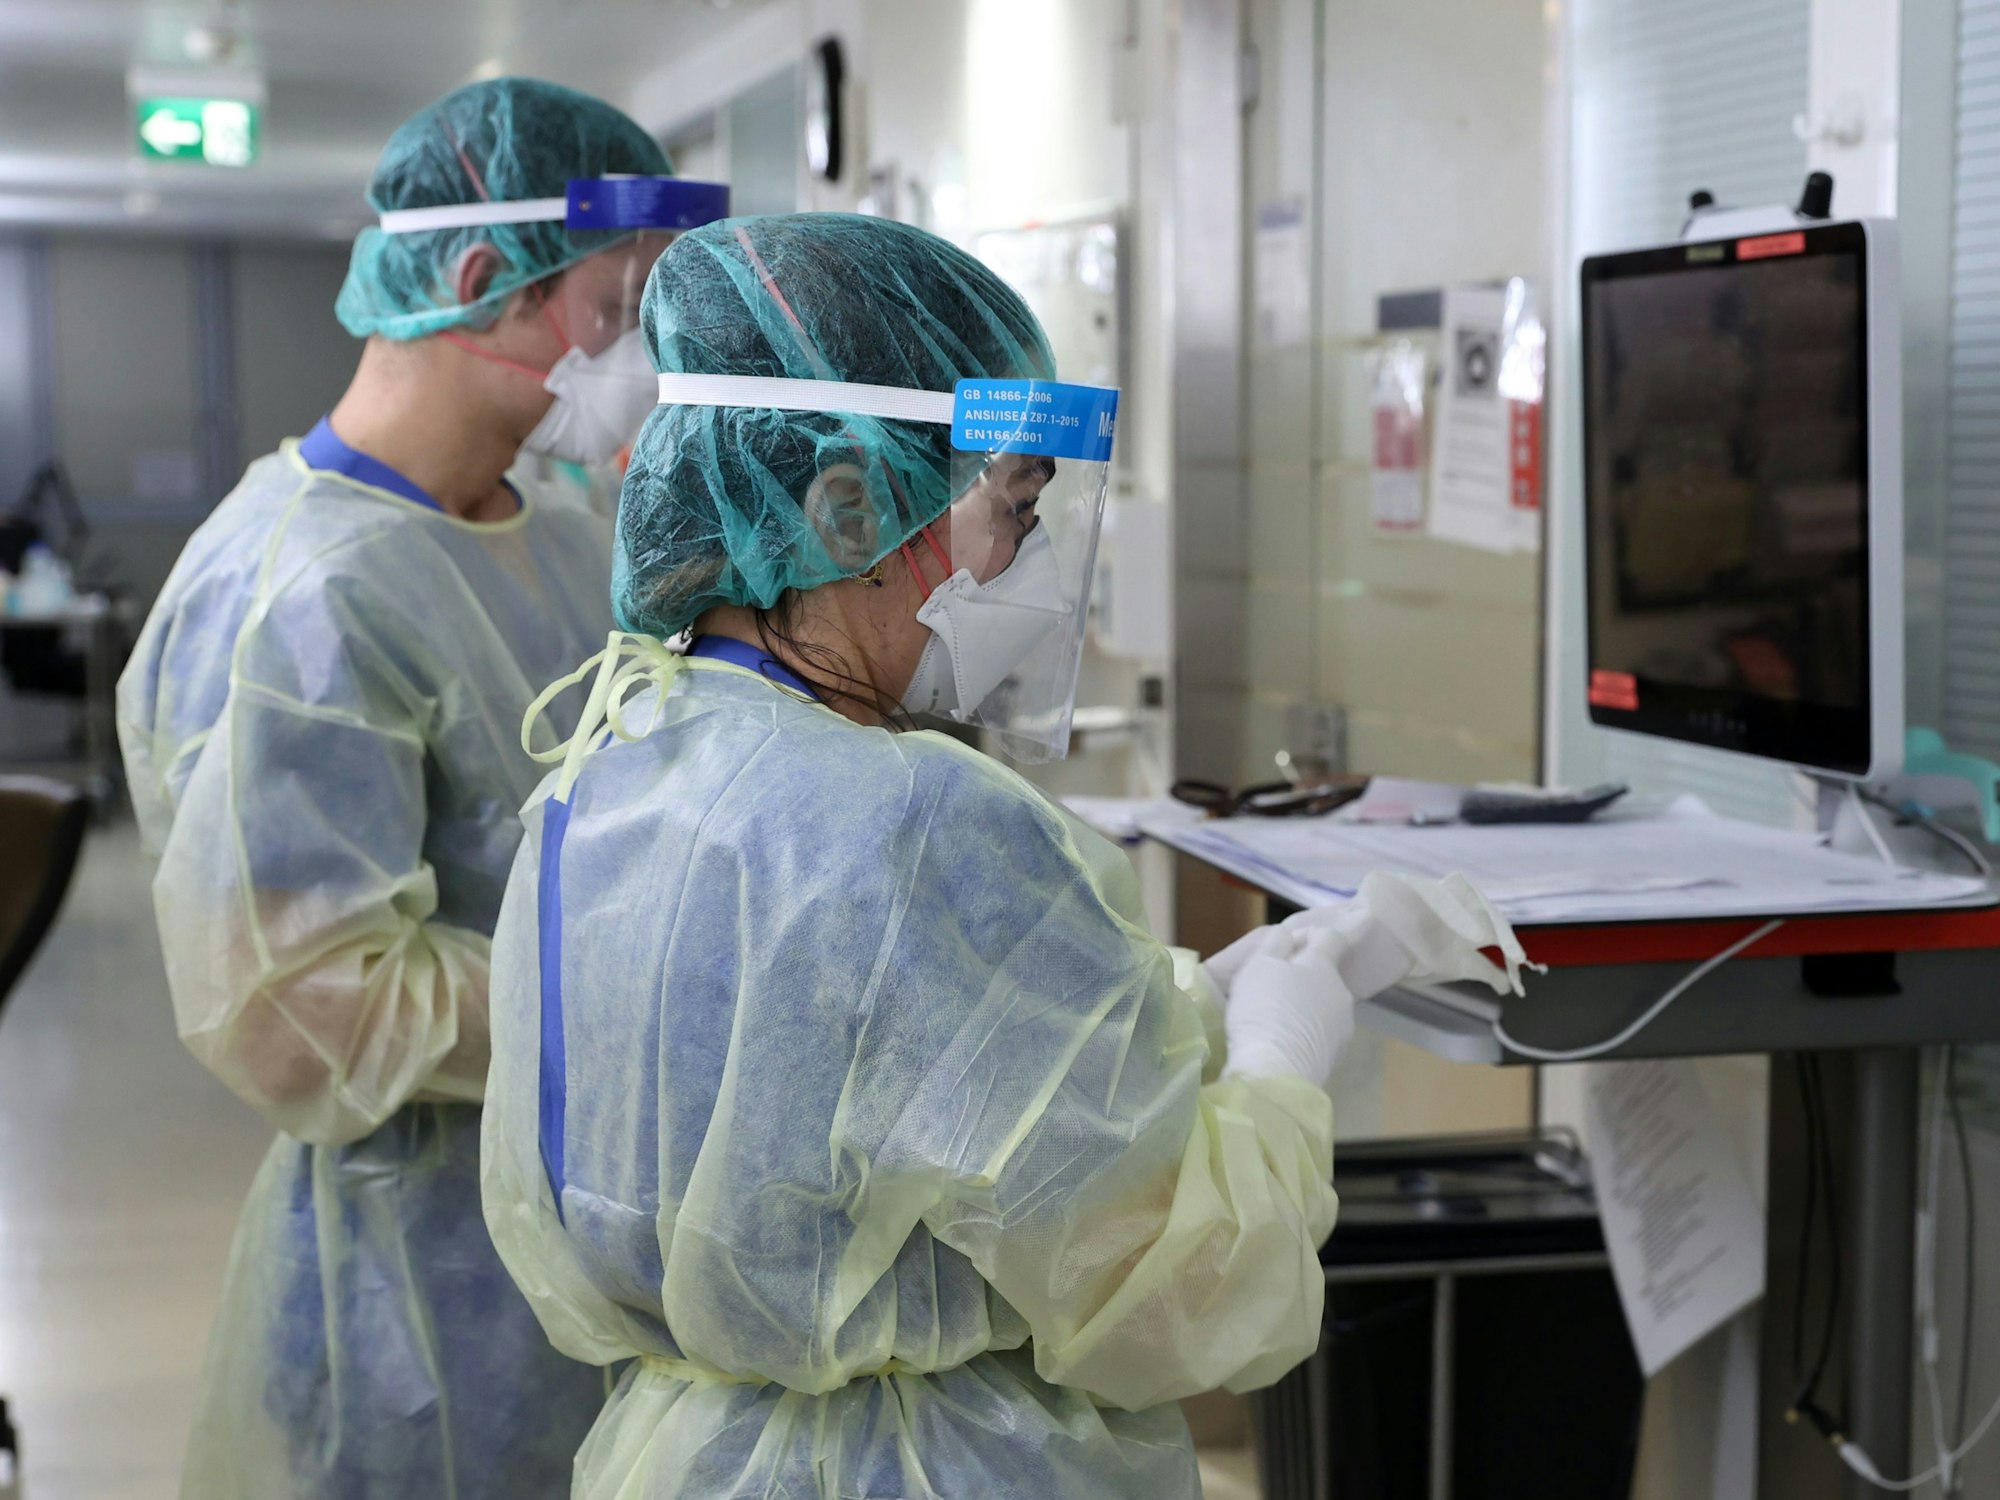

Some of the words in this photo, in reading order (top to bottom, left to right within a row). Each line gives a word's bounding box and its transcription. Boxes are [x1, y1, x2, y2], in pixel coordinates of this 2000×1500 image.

[963, 389, 981, 400] GB
[987, 390, 1052, 403] 14866-2006
[964, 409, 1028, 422] ANSI/ISEA
[1030, 411, 1079, 427] Z87.1-2015
[965, 429, 1042, 443] EN166:2001
